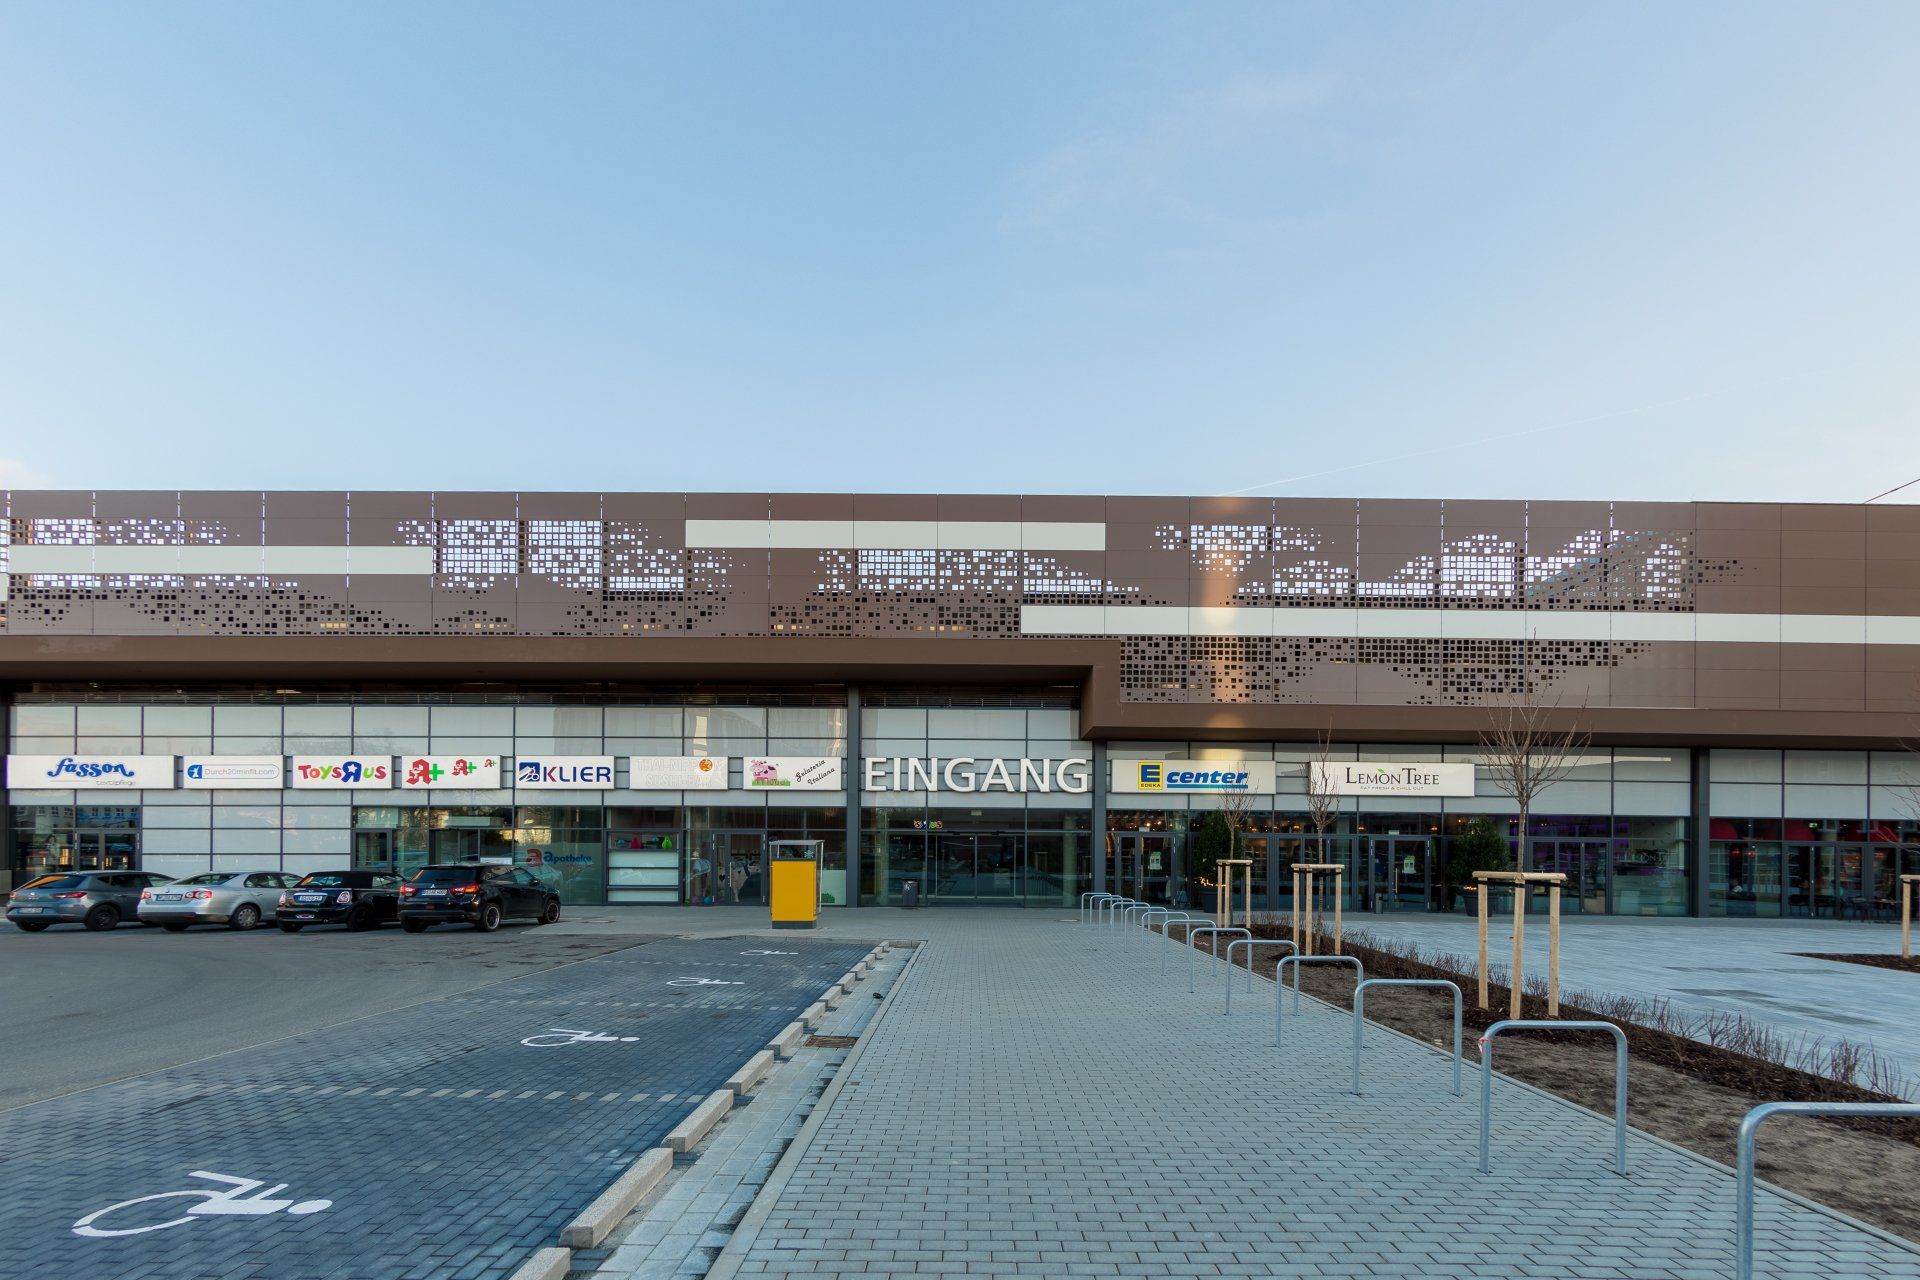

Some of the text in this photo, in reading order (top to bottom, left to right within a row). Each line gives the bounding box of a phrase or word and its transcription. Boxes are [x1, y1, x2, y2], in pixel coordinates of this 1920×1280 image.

[47, 758, 135, 777] fasson
[543, 766, 612, 783] KLIER
[795, 759, 826, 783] Gelateria
[807, 768, 836, 785] Italiana
[864, 757, 1090, 794] EINGANG
[1166, 770, 1248, 784] center
